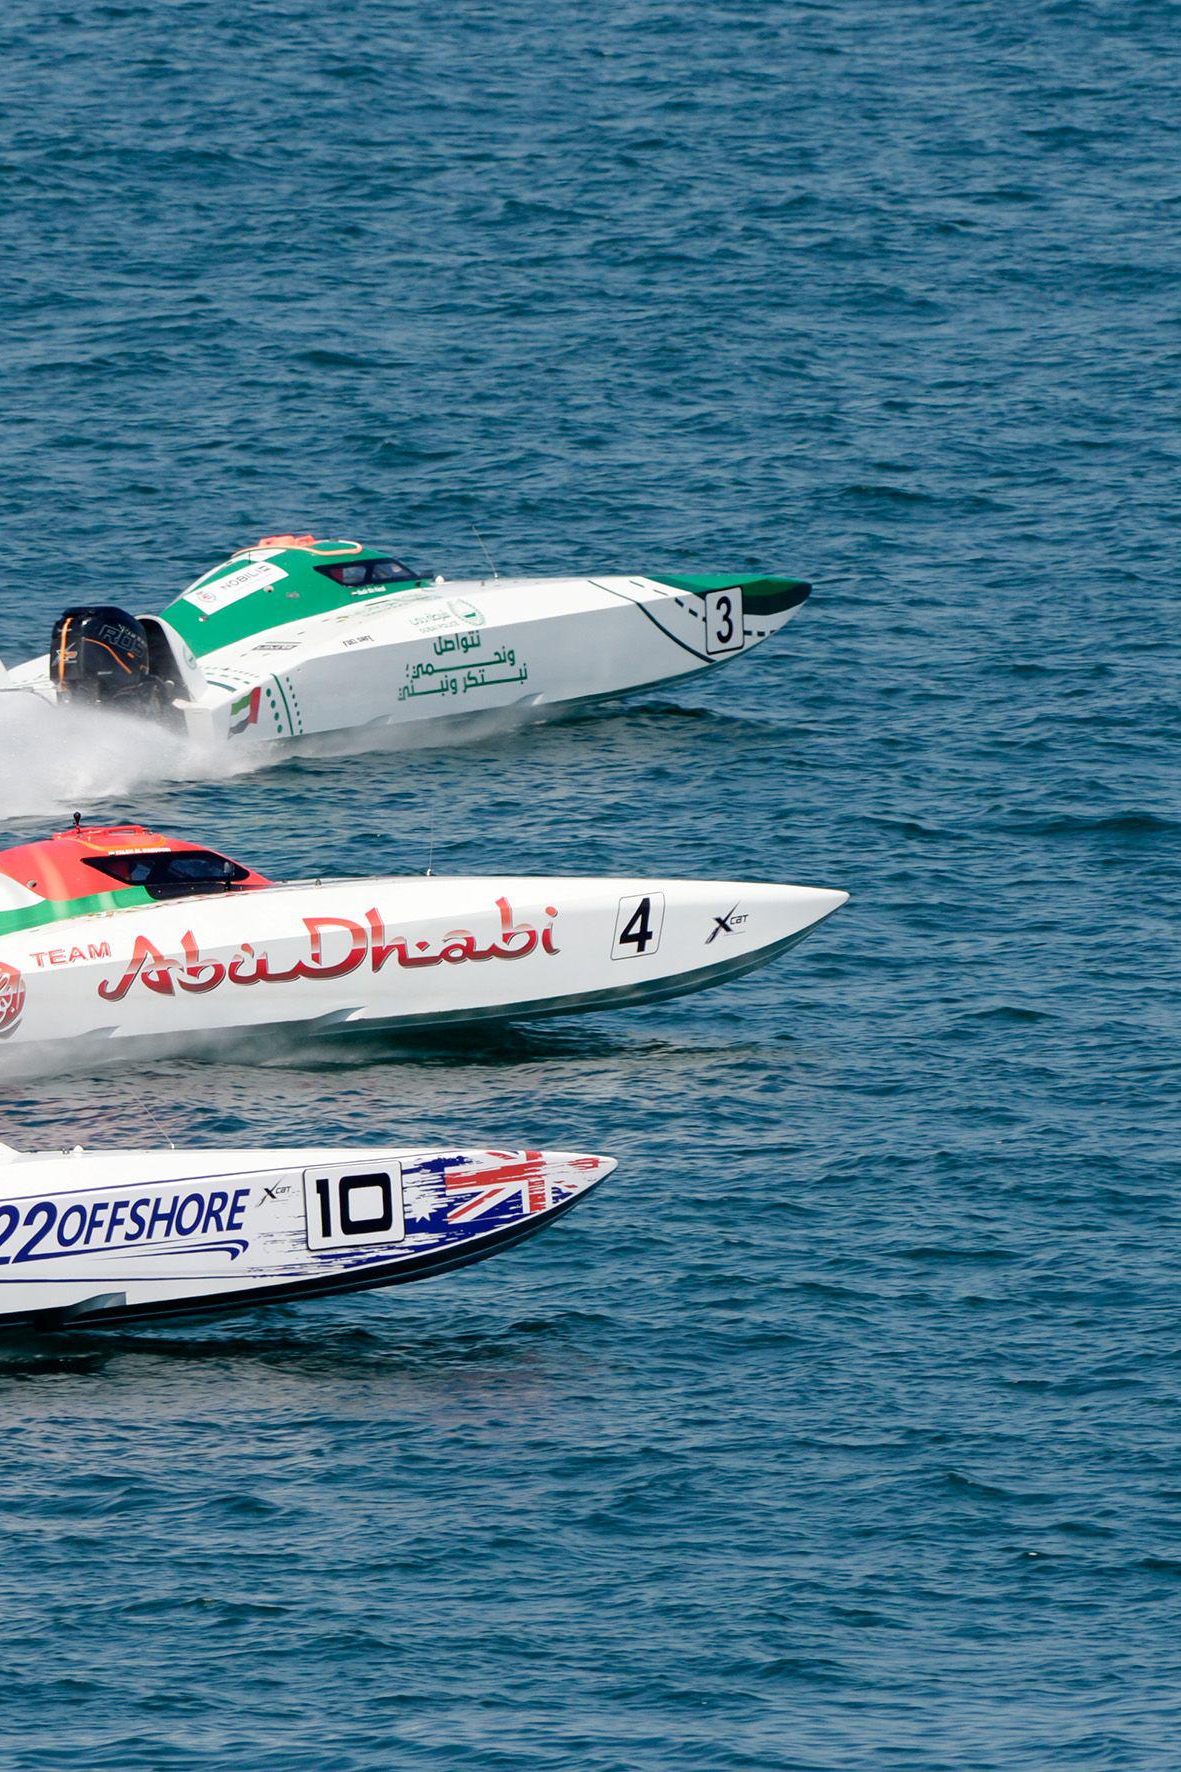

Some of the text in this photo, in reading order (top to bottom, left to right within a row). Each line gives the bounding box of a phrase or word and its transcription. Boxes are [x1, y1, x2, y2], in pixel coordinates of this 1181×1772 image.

[433, 630, 481, 656] نتواصل
[716, 595, 733, 643] 3
[618, 897, 653, 953] 4
[29, 942, 112, 968] TEAM
[315, 1172, 393, 1237] 10
